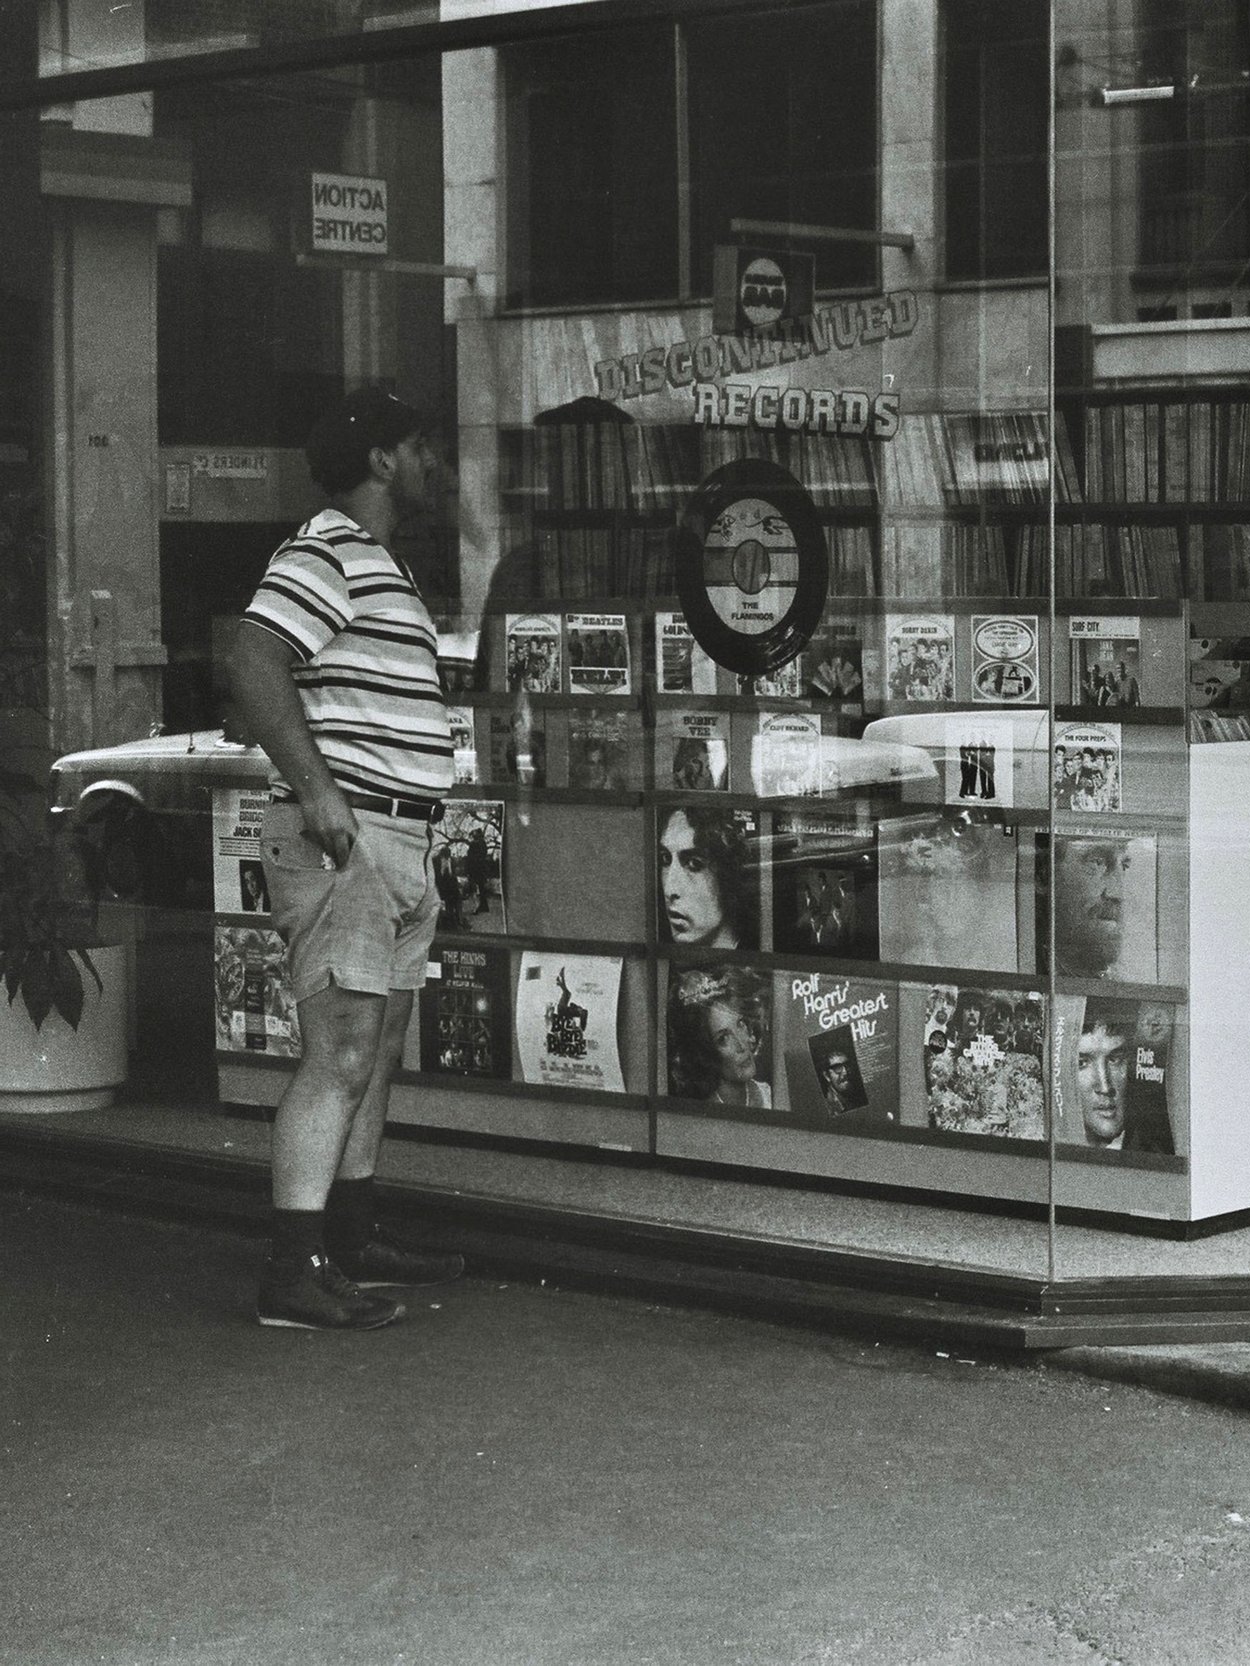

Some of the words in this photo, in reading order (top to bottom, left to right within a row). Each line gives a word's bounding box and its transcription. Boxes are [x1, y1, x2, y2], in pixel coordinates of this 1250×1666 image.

[594, 289, 920, 402] DISCONTINUED
[695, 382, 900, 441] RECORDS
[742, 602, 759, 610] THE
[582, 617, 623, 626] BEATLES
[731, 612, 774, 621] FLAMINGOS
[1072, 621, 1085, 632] SURF
[1087, 621, 1100, 632] CITY
[683, 715, 718, 726] BOBBY
[689, 727, 710, 736] VEE
[1090, 735, 1107, 743] PREPS
[442, 951, 459, 964] THE
[791, 973, 820, 1001] Rolf
[804, 981, 850, 1017] Harris'
[818, 992, 889, 1031] Greatest
[850, 1018, 878, 1042] Hits
[1136, 1047, 1155, 1065] Elvis
[1136, 1063, 1165, 1084] Presley
